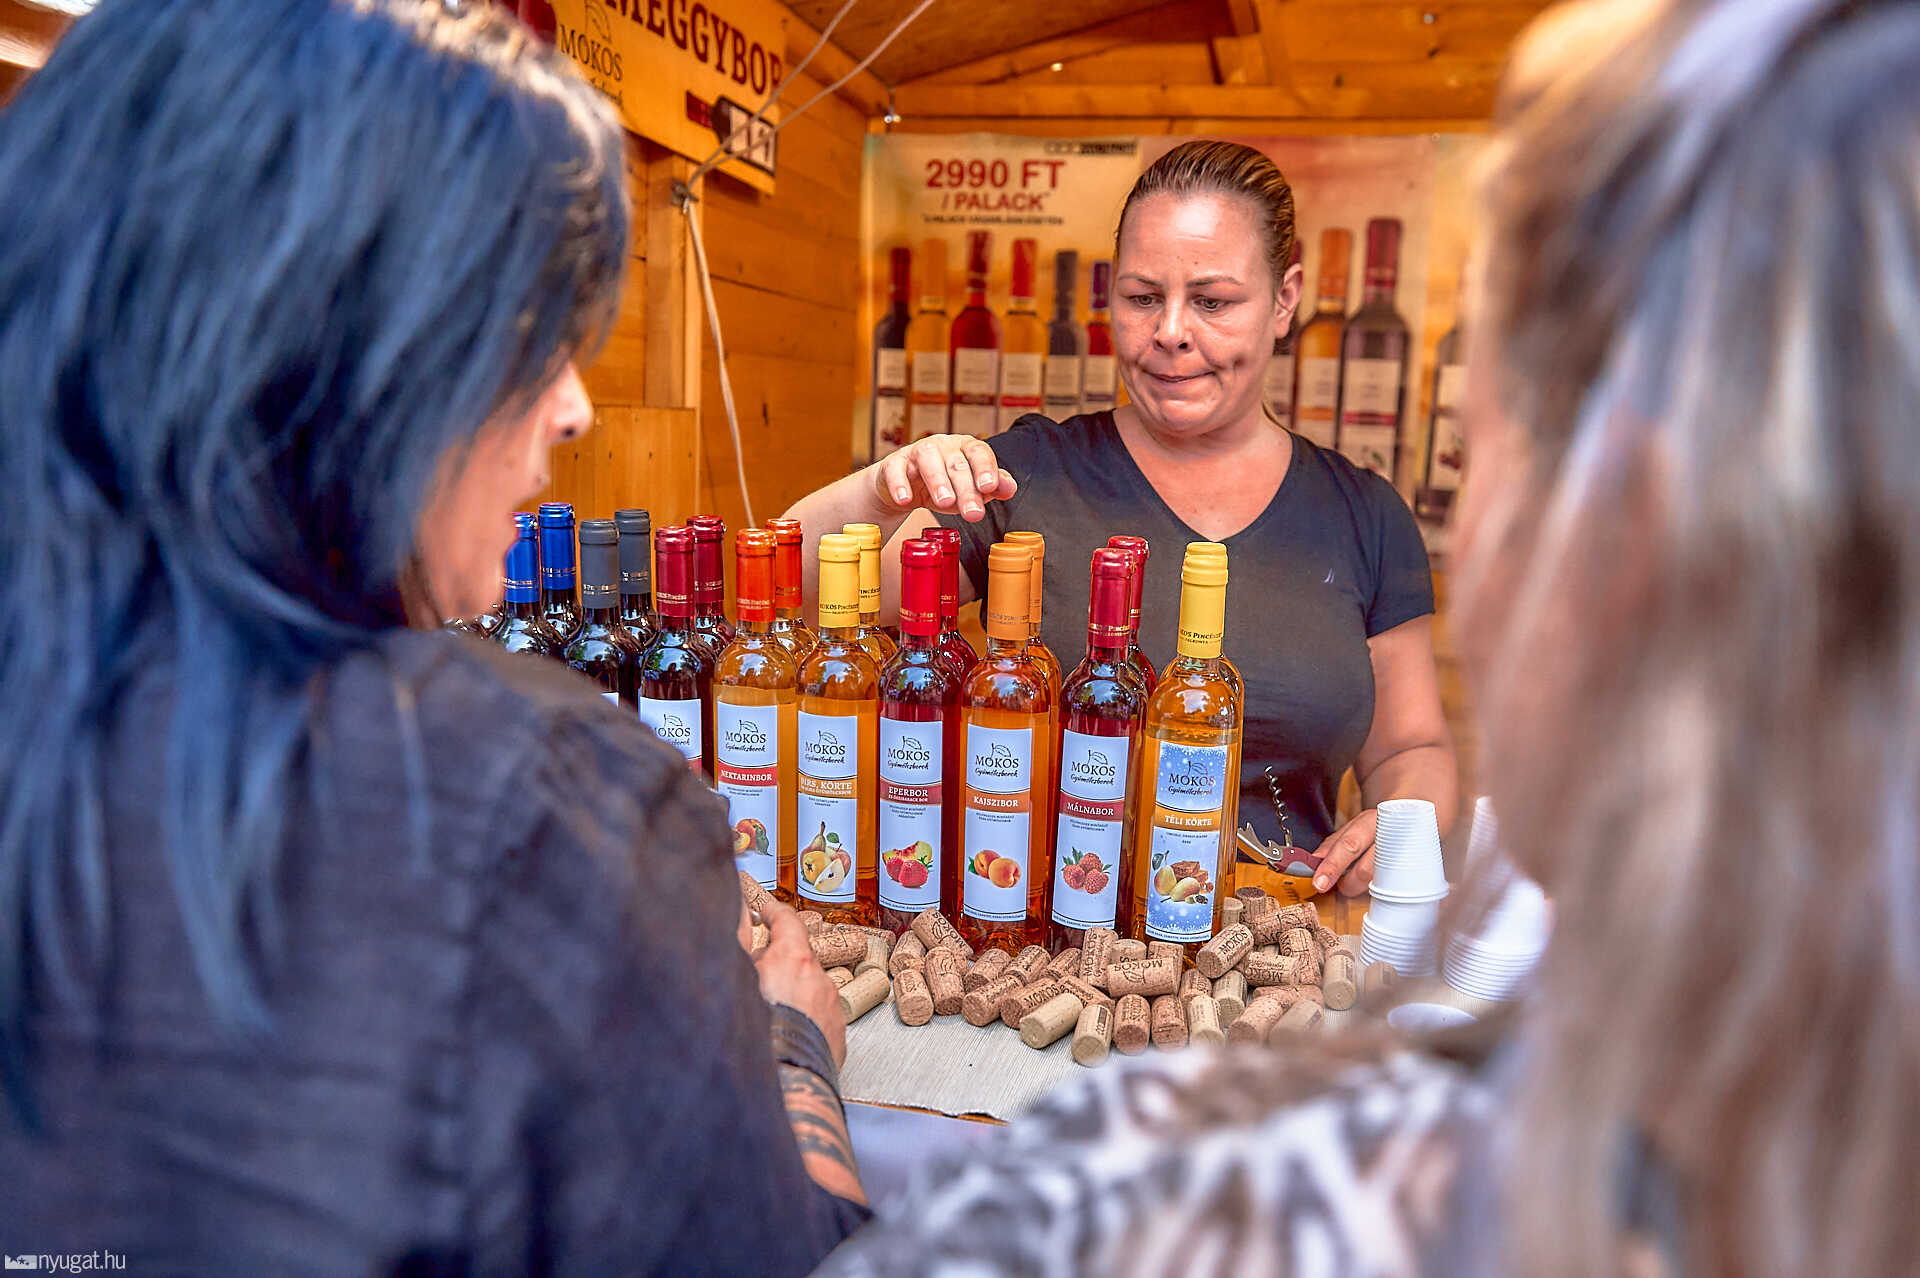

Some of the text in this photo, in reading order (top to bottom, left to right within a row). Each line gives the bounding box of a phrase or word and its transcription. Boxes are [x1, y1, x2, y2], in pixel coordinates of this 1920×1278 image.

[560, 24, 624, 82] MOKOS
[925, 158, 1067, 189] 2990 FT
[654, 726, 692, 738] OKOS
[725, 731, 767, 744] MOKOS
[805, 741, 846, 756] MOKOS
[888, 747, 931, 762] MOKOS
[975, 755, 1020, 769] MOKOS
[1071, 761, 1116, 777] MOKOS
[720, 769, 773, 782] NEKTARINBOR
[1169, 773, 1216, 787] MOKOS
[820, 780, 853, 790] KÖRTE
[889, 785, 929, 797] EPERBOR
[973, 795, 1019, 808] KAJSZIBOR
[1067, 802, 1115, 816] MÁLNABOR
[1164, 814, 1213, 827] TÉLI KÖRTE
[1220, 928, 1249, 956] MOKOS
